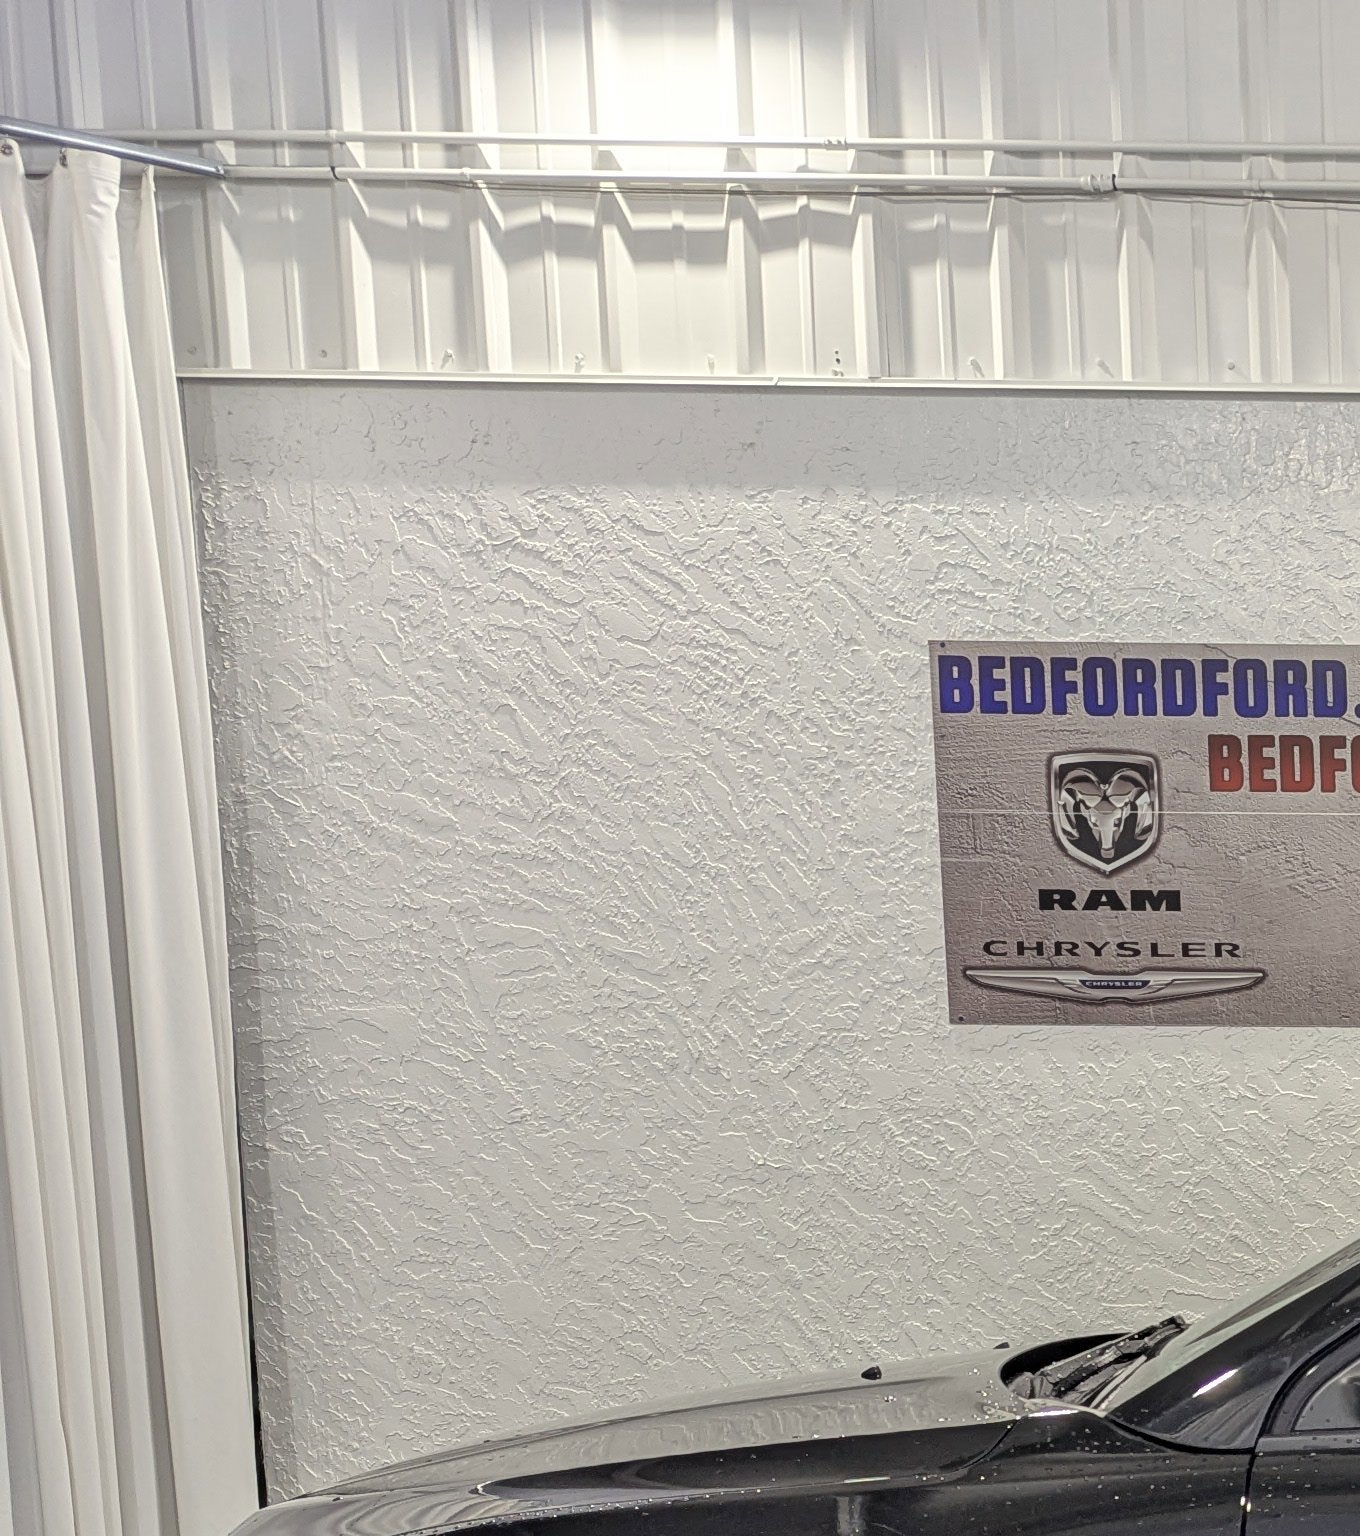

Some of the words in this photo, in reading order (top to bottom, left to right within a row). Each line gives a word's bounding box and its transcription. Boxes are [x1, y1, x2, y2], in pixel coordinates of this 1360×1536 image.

[1038, 888, 1182, 912] RAM
[982, 940, 1242, 958] CHRYSLER
[1085, 980, 1143, 988] CHRYSLER
